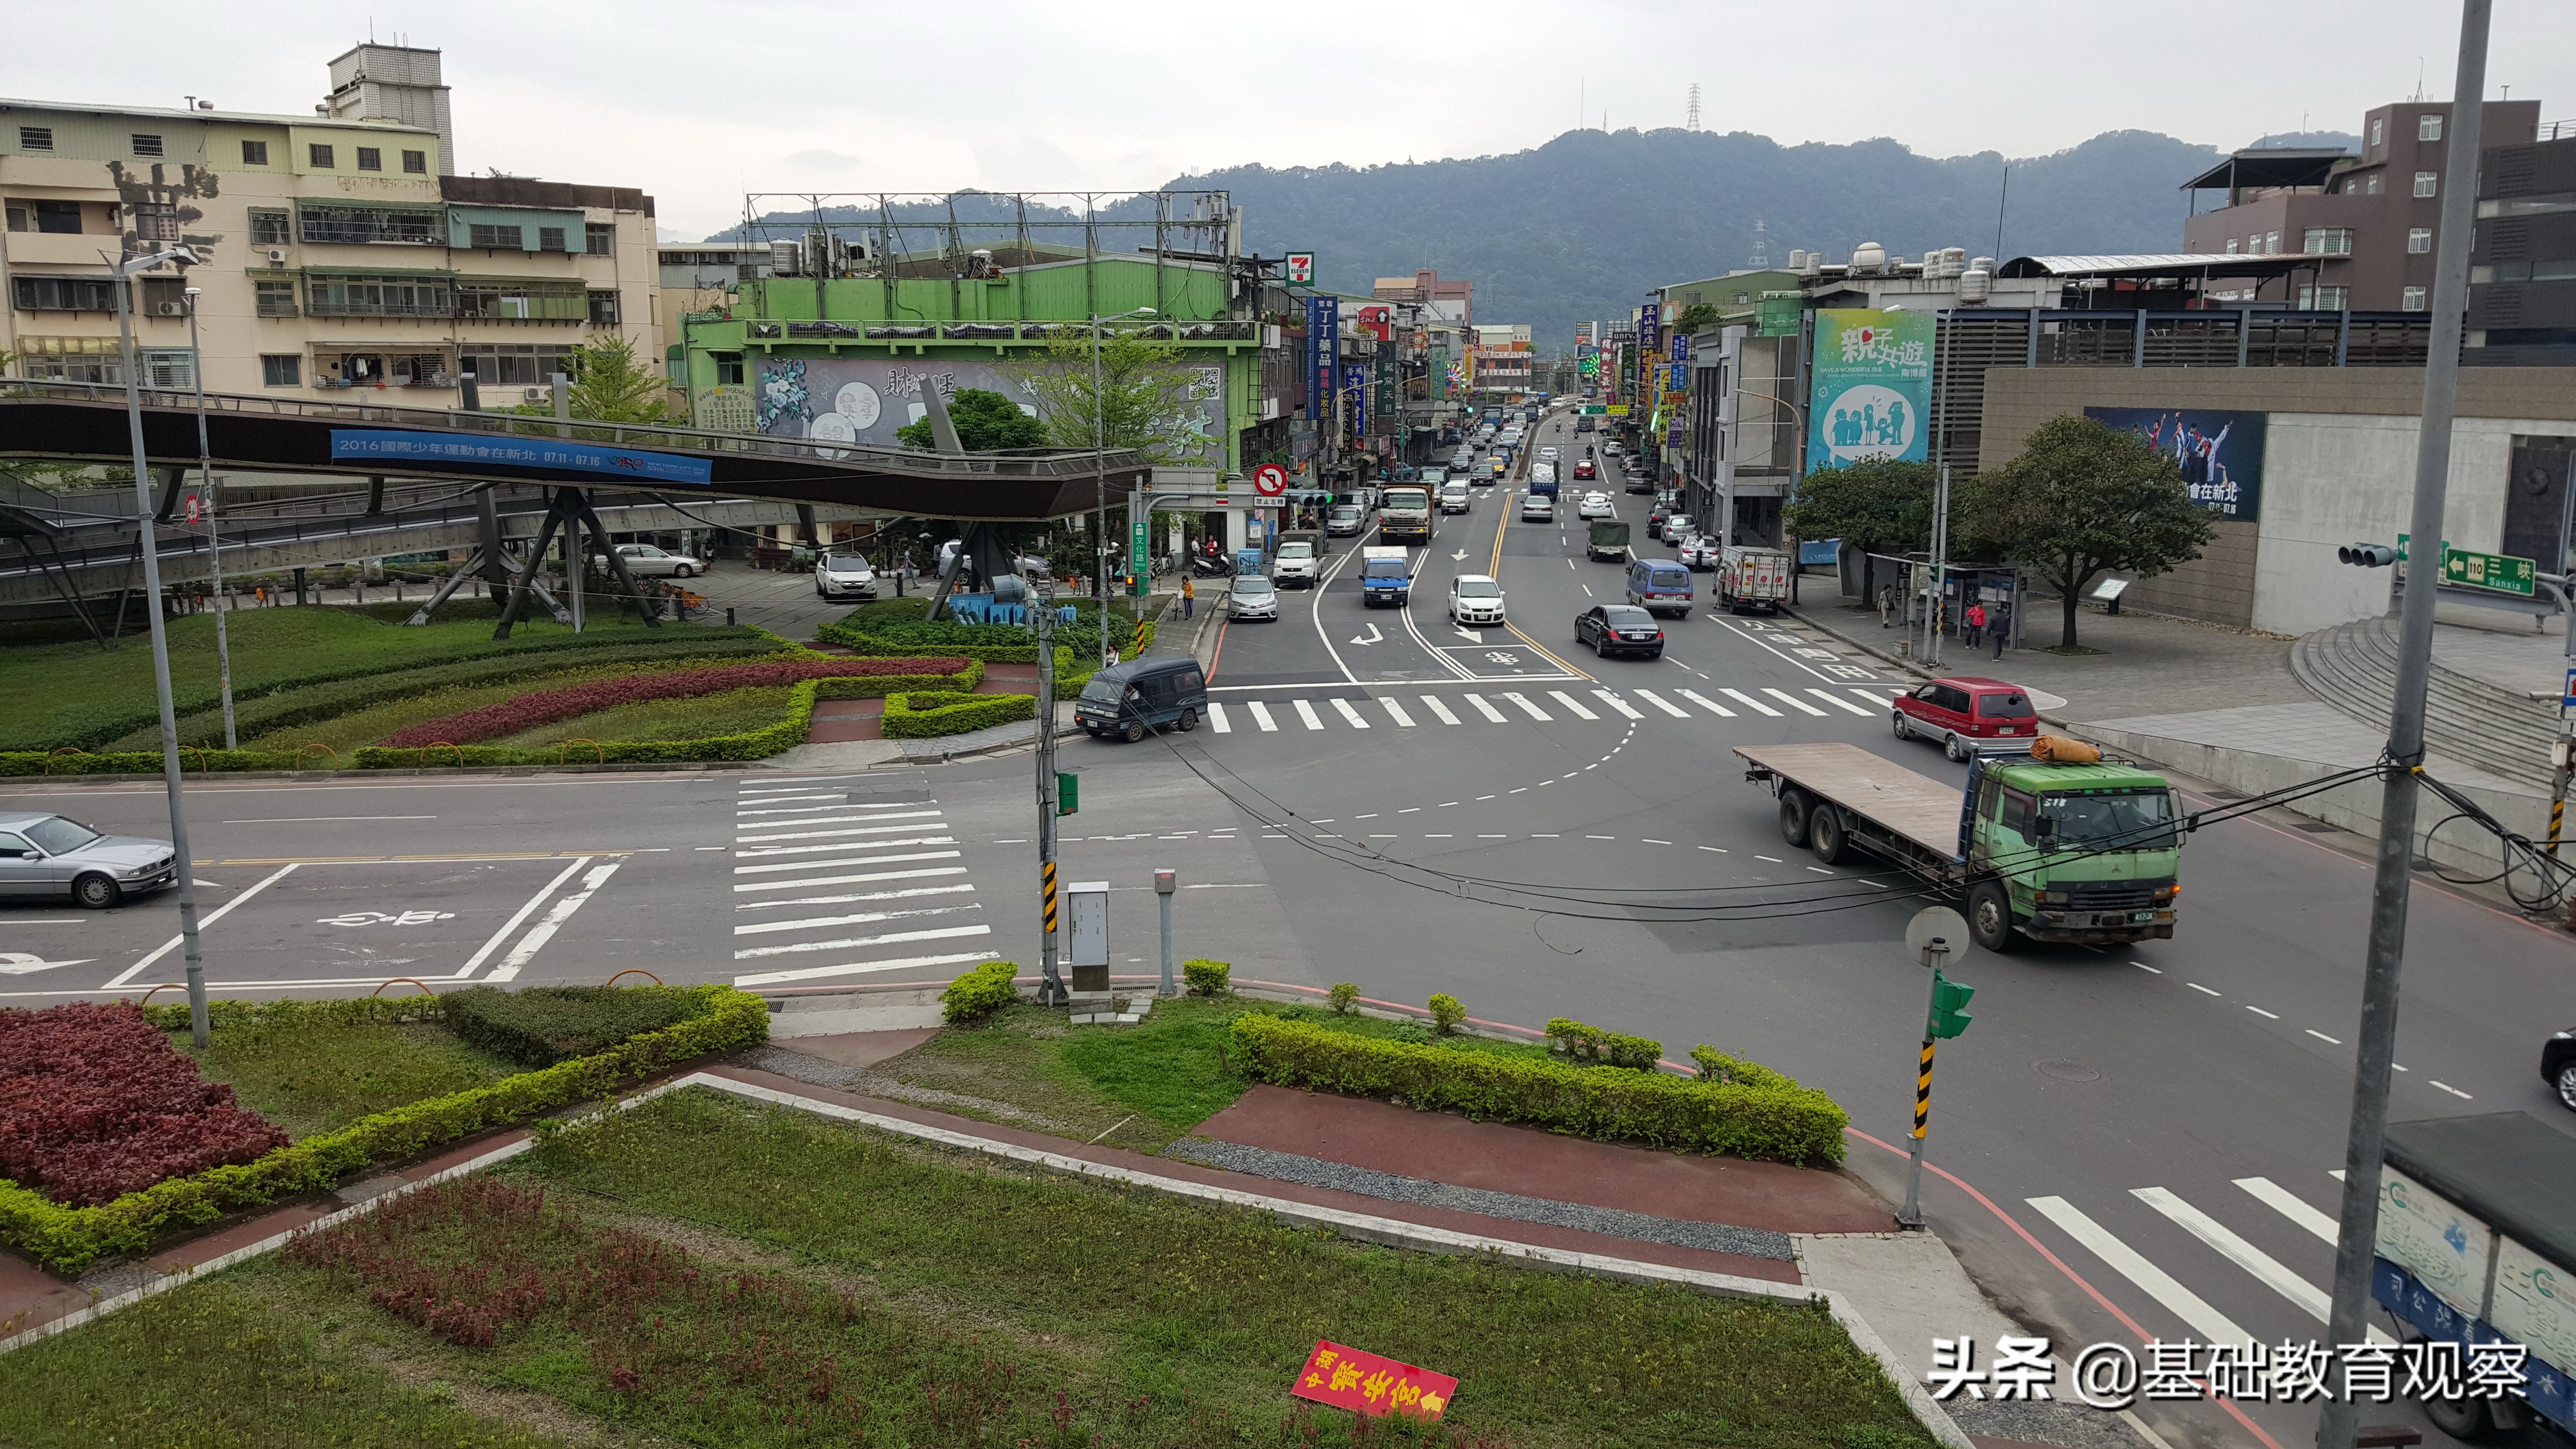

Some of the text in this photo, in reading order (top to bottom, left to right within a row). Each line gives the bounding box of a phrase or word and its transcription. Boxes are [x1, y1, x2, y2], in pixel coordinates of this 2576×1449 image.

[1642, 306, 1656, 345] 玉山旅店
[1840, 325, 1928, 369] 親子共遊
[545, 451, 567, 463] 07.11
[576, 454, 600, 467] 07.16
[2223, 503, 2237, 515] 07.16
[1136, 536, 1144, 562] 文化路
[2469, 562, 2483, 575] 110
[2488, 558, 2531, 580] 三峽
[2489, 577, 2521, 591] Sanxia
[1328, 1360, 1421, 1409] 寶安宮
